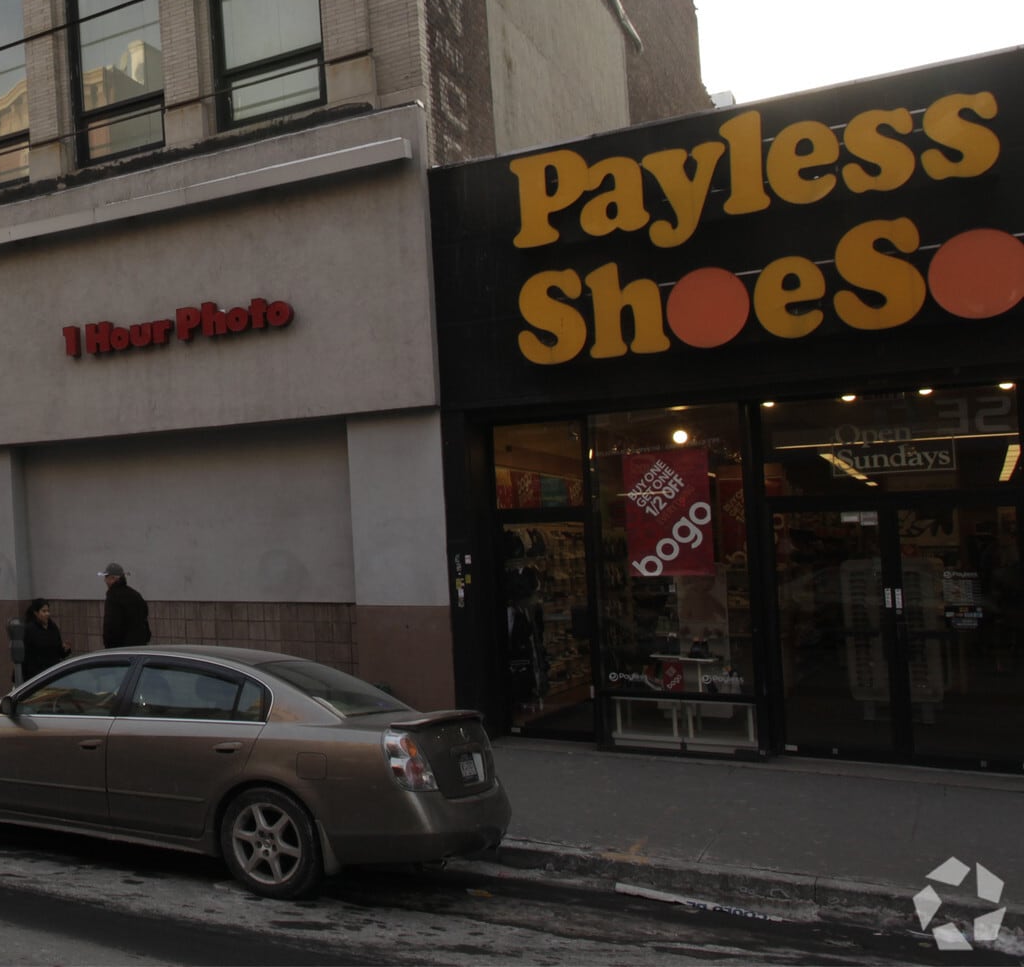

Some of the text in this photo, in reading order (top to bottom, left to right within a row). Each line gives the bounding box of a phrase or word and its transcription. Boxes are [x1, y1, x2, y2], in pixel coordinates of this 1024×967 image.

[509, 91, 1000, 248] Payless
[63, 298, 294, 358] 1 Hour Photo
[835, 424, 912, 448] Open
[628, 459, 666, 501] BUY ONE
[836, 445, 951, 474] Sundays
[636, 466, 675, 508] GET ONE
[645, 496, 668, 517] 1/2
[663, 473, 685, 499] OFF
[632, 501, 712, 576] bogo
